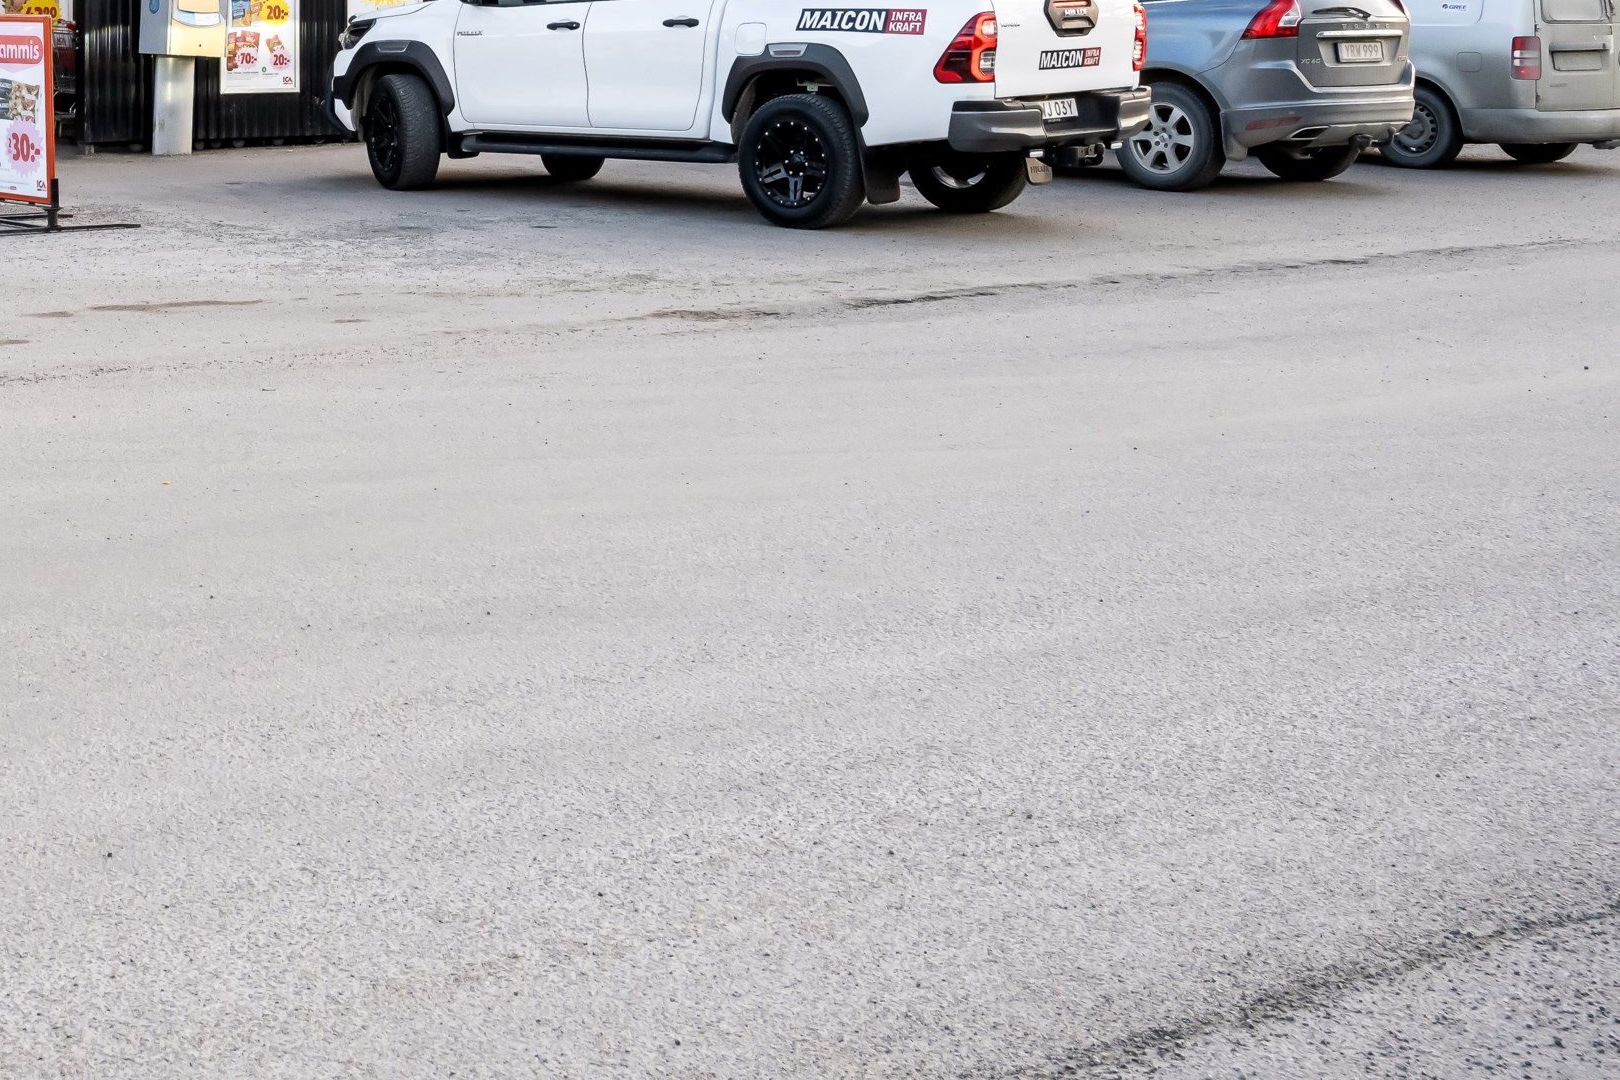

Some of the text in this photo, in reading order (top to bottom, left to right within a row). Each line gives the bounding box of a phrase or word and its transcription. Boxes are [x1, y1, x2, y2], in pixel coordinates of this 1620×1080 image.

[267, 5, 288, 20] 20:-
[799, 11, 922, 30] MAICON INFRA
[889, 22, 921, 32] KRAFT
[1363, 44, 1378, 57] 999
[273, 54, 290, 65] 20:-
[1040, 50, 1084, 68] MAICON
[12, 132, 40, 162] 30:-
[37, 180, 46, 189] ICA
